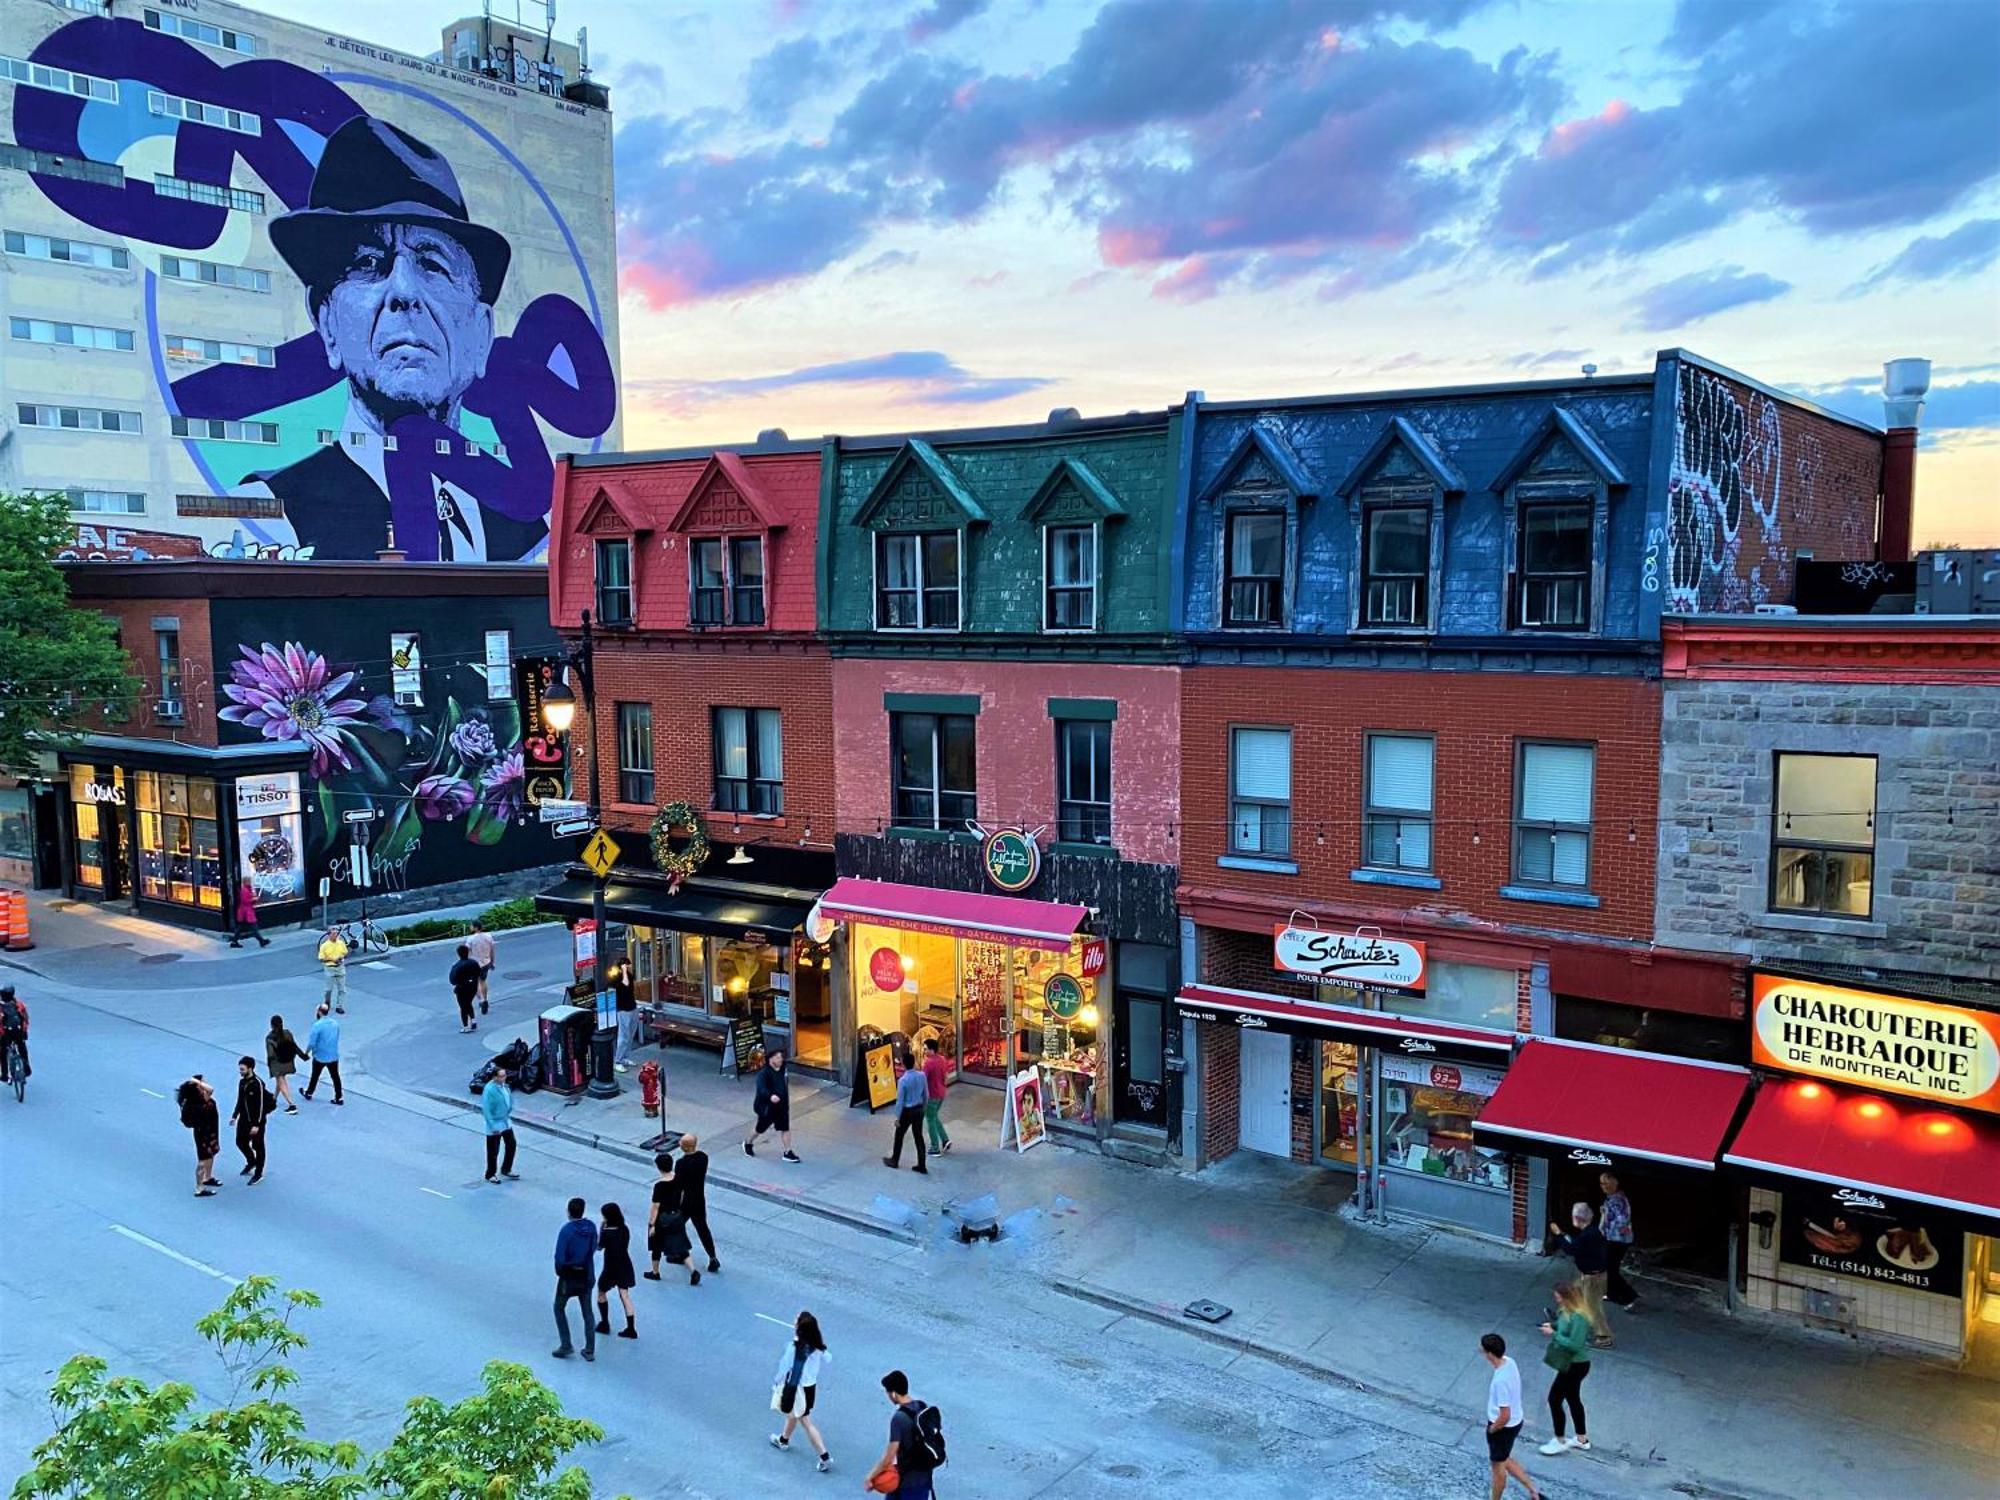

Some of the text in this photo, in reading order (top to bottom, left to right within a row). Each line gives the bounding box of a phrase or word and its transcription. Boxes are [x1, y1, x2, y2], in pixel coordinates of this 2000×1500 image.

[246, 791, 290, 803] TISSOT
[1084, 946, 1105, 973] illy
[1296, 973, 1320, 985] POUR
[1321, 976, 1365, 992] EMPORTER
[1774, 993, 1977, 1050] CHARCUTERIE
[1783, 1022, 1969, 1077] HEBRAIQUE
[1789, 1048, 1967, 1094] DE MONTREAL INC.
[1840, 1260, 1872, 1276] (514)
[1873, 1266, 1931, 1287] 842-4813
